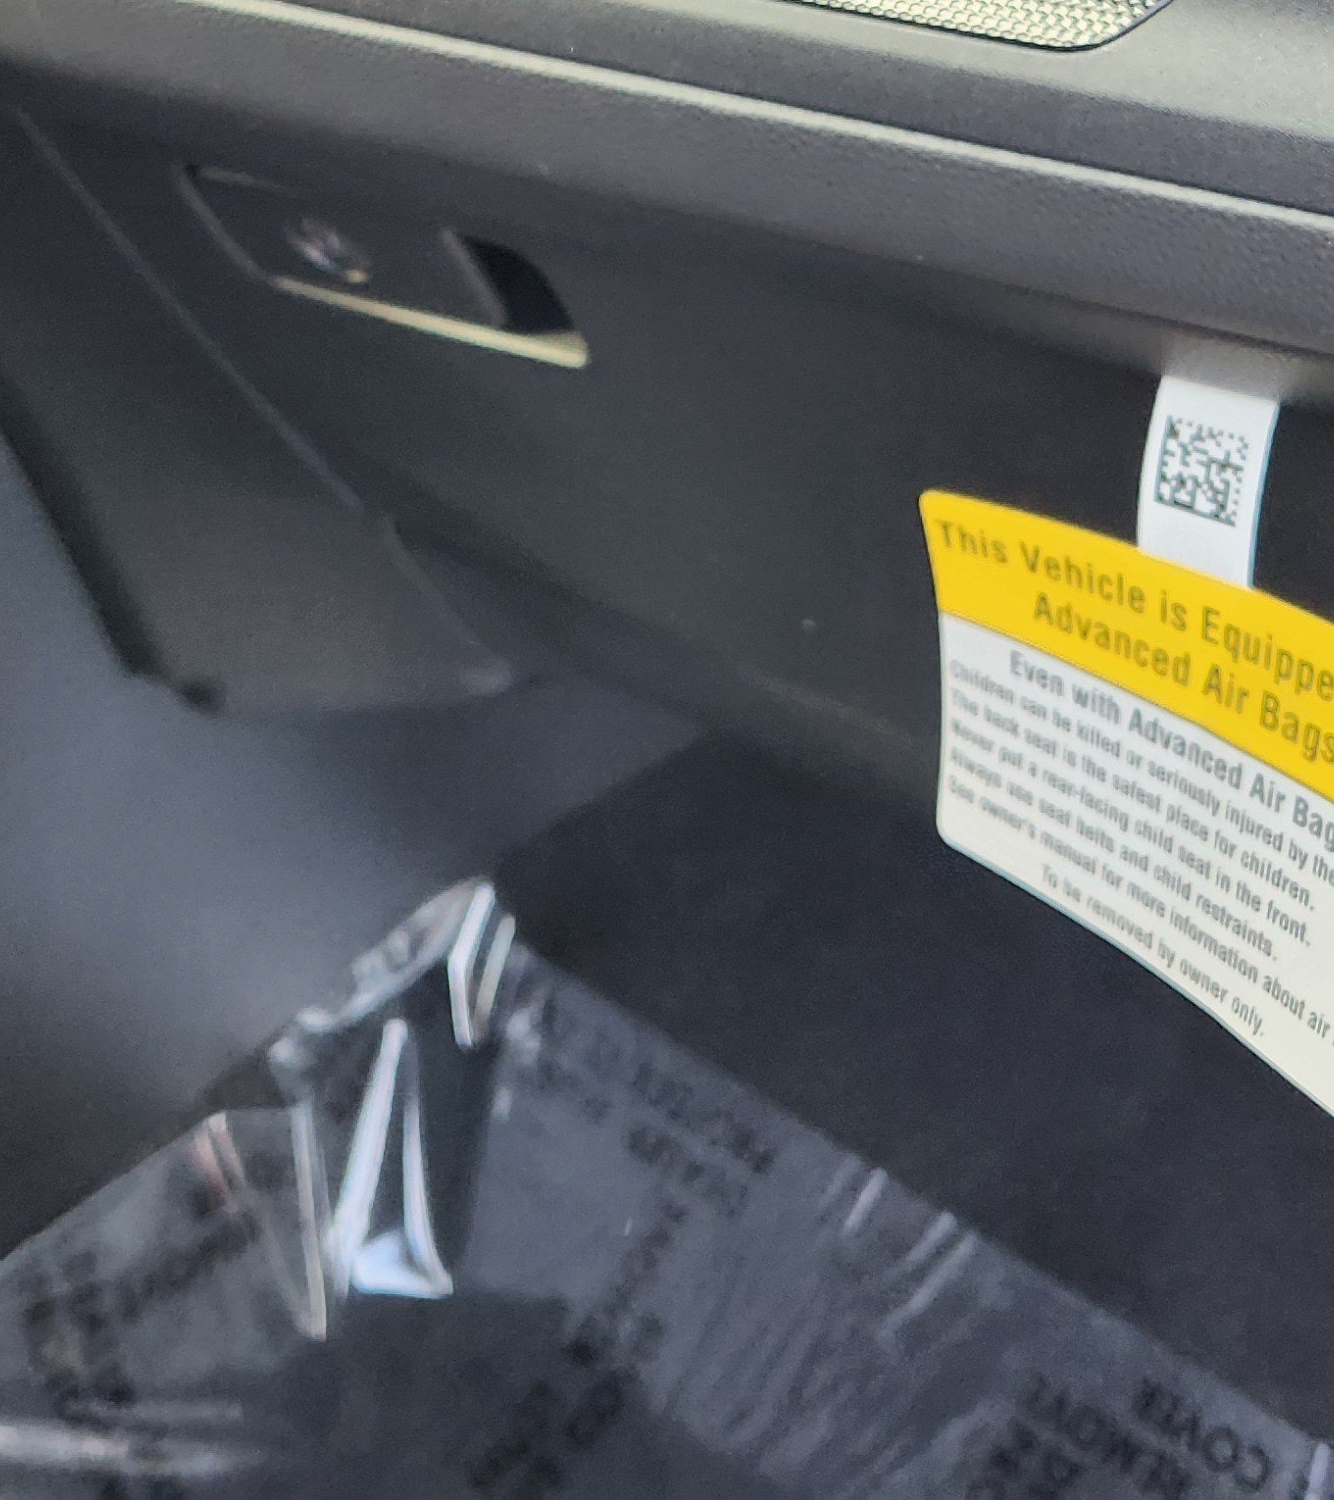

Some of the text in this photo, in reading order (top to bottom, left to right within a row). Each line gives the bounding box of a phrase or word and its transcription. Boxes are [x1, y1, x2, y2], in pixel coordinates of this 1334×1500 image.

[937, 520, 1008, 564] This
[1019, 541, 1146, 614] Vehicle
[1160, 590, 1188, 632] is
[1033, 591, 1192, 687] Advanced
[1201, 663, 1250, 714] Air
[1009, 649, 1065, 697] Even
[1071, 684, 1123, 725] with
[1128, 708, 1243, 790] Advanced
[1249, 772, 1286, 813] Air
[1020, 695, 1048, 721] can
[1052, 708, 1071, 732] be
[1076, 721, 1120, 758] killed
[1126, 748, 1143, 769] or
[1148, 760, 1220, 817] seriously
[1225, 800, 1283, 852] injured
[1287, 838, 1308, 870] by
[1024, 727, 1058, 757] seat
[1062, 746, 1076, 768] is
[1081, 754, 1106, 783] the
[1112, 772, 1161, 813] safest
[1166, 803, 1209, 842] place
[1214, 829, 1237, 860] for
[1240, 849, 1315, 911] children.
[1038, 798, 1071, 828] seat
[1076, 815, 1114, 854] belts
[1119, 844, 1149, 873] and
[1153, 863, 1191, 901] child
[1195, 891, 1277, 962] restraints.
[1042, 768, 1129, 833] rear-facing
[1134, 818, 1173, 854] child
[1178, 845, 1211, 881] seat
[1216, 866, 1231, 896] in
[1236, 880, 1261, 913] the
[1267, 899, 1311, 947] front.
[1062, 877, 1081, 902] be
[1086, 896, 1153, 949] removed
[1158, 938, 1175, 969] by
[1179, 957, 1229, 1002] owner
[1231, 996, 1264, 1037] only.
[1127, 880, 1166, 918] more
[1170, 905, 1259, 984] information
[1263, 973, 1307, 1020] about
[1307, 1008, 1331, 1039] air
